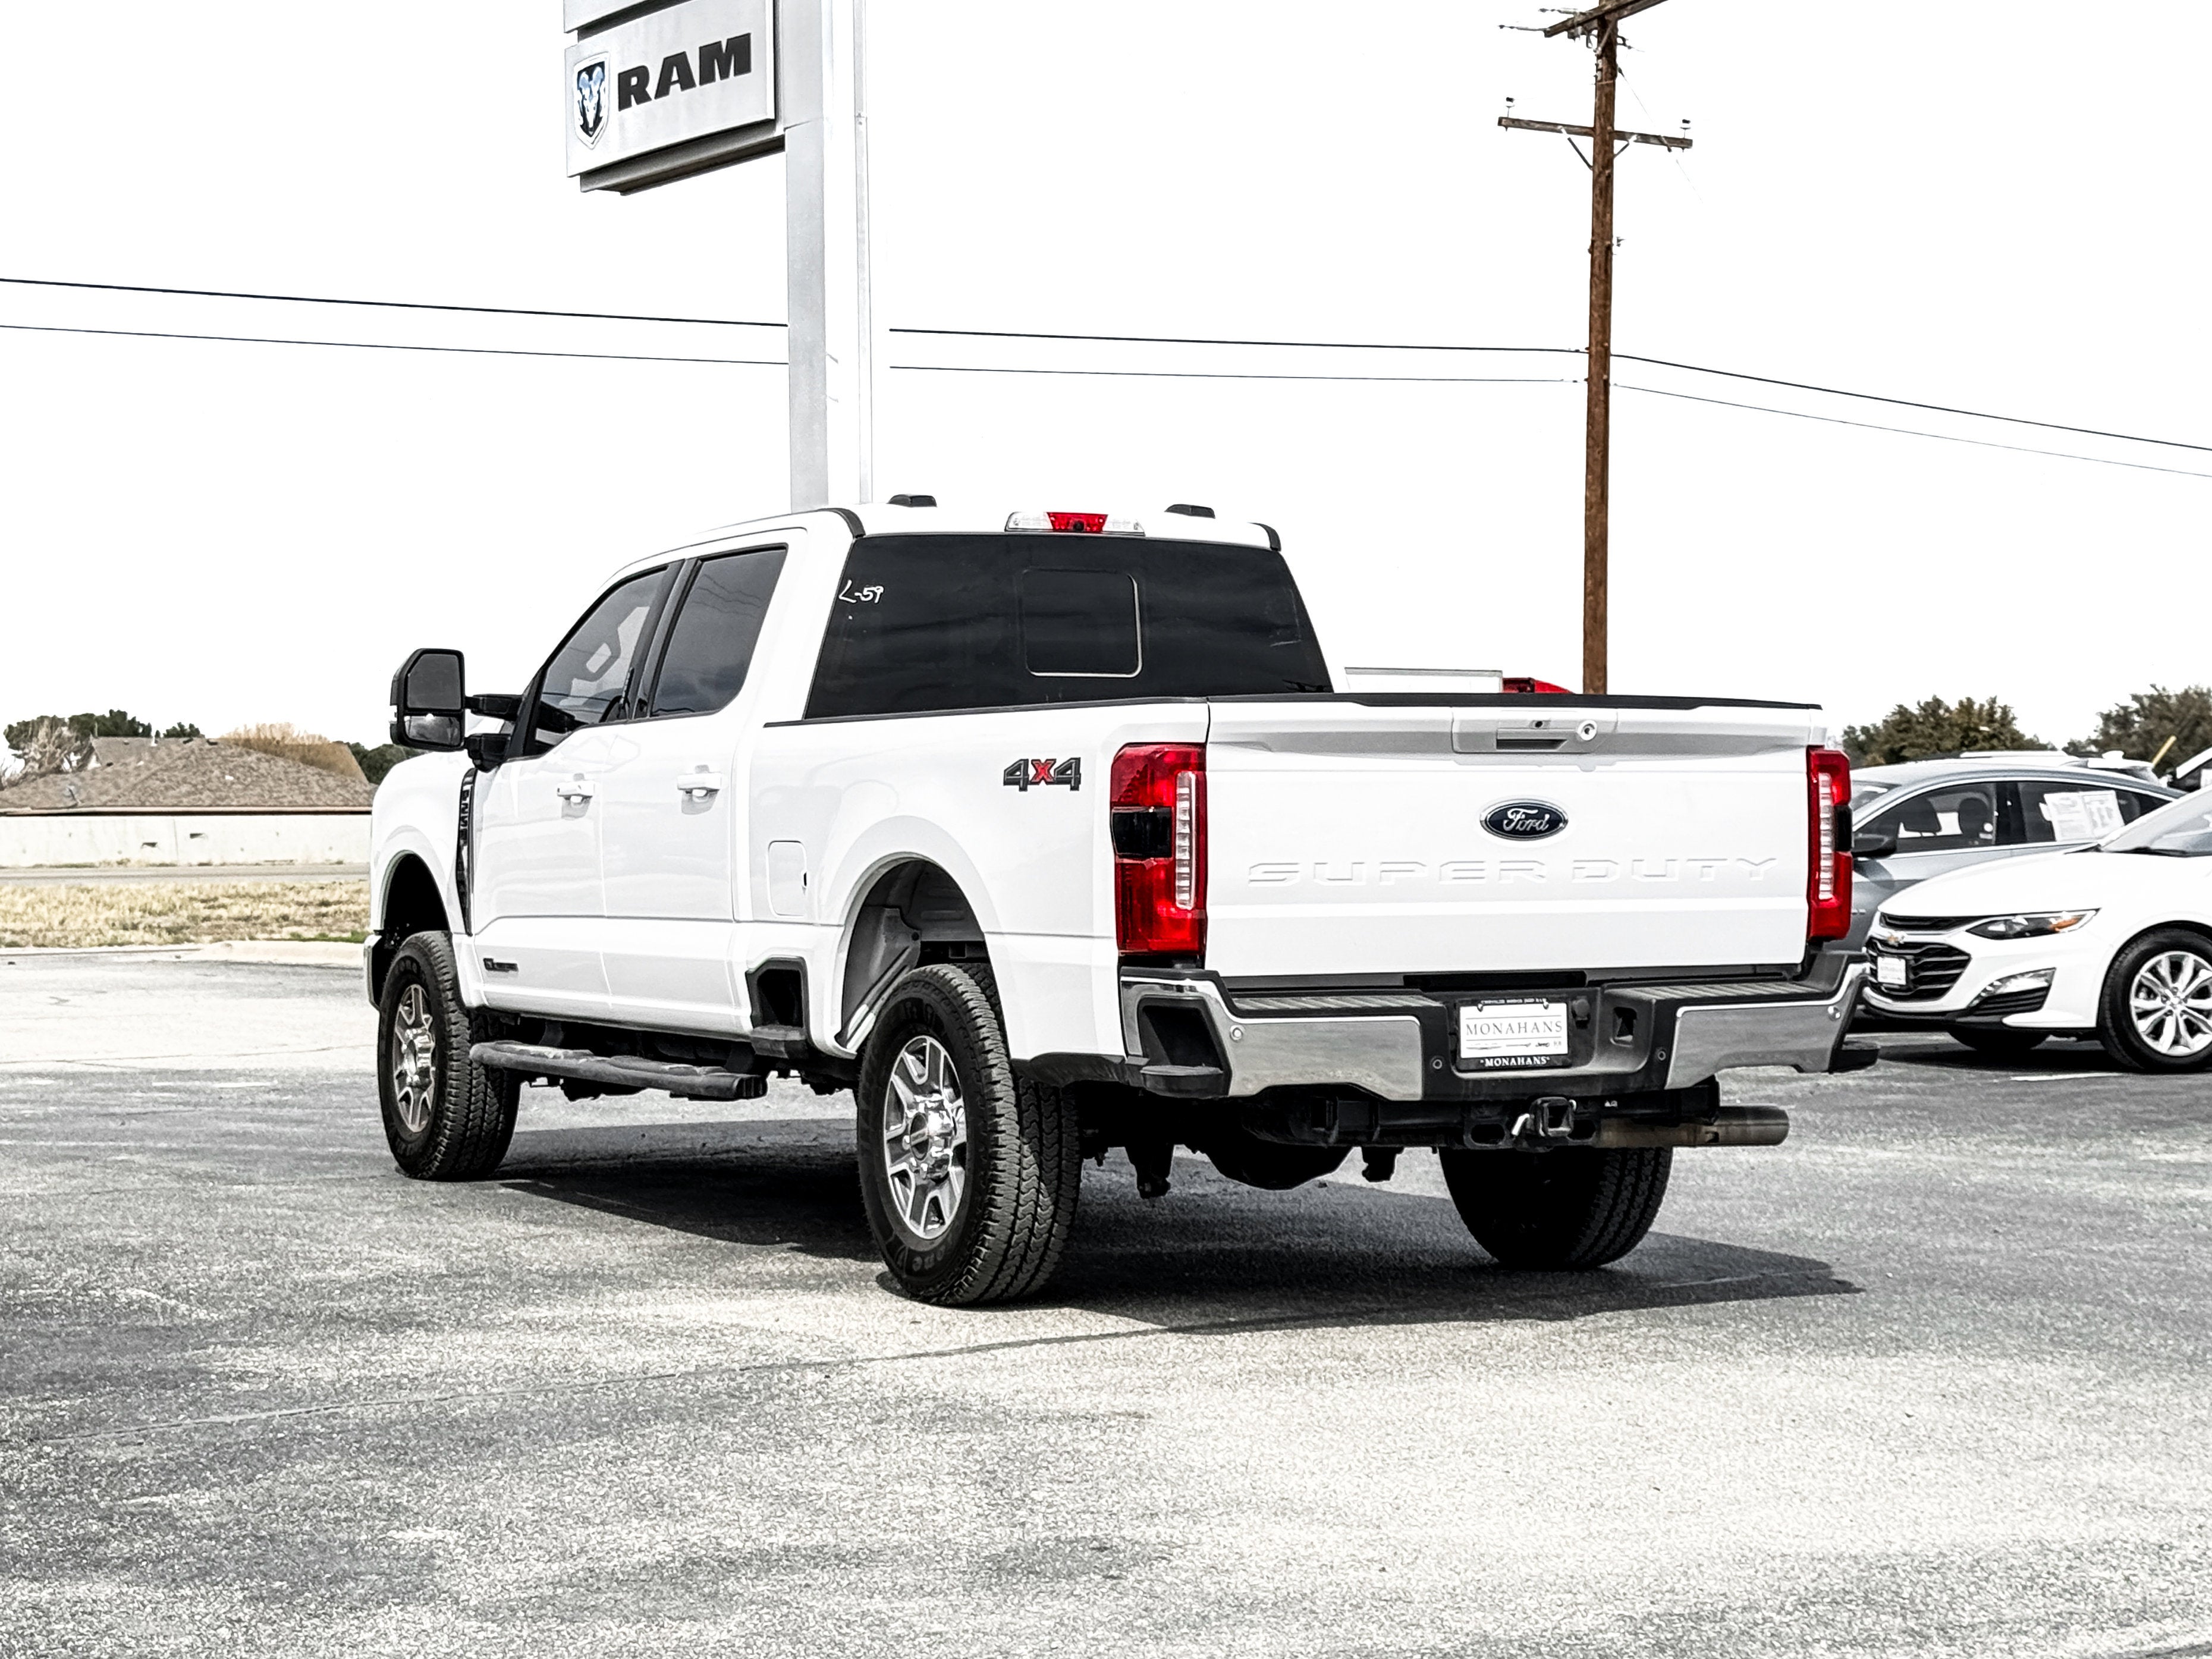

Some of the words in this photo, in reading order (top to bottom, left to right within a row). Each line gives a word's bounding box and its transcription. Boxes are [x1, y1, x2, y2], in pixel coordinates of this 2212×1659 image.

[618, 32, 752, 112] RAM
[1503, 807, 1550, 831] Ford
[1248, 860, 1548, 887] SUPER
[1571, 858, 1777, 884] DUTY
[1466, 1020, 1563, 1036] MONAHANS
